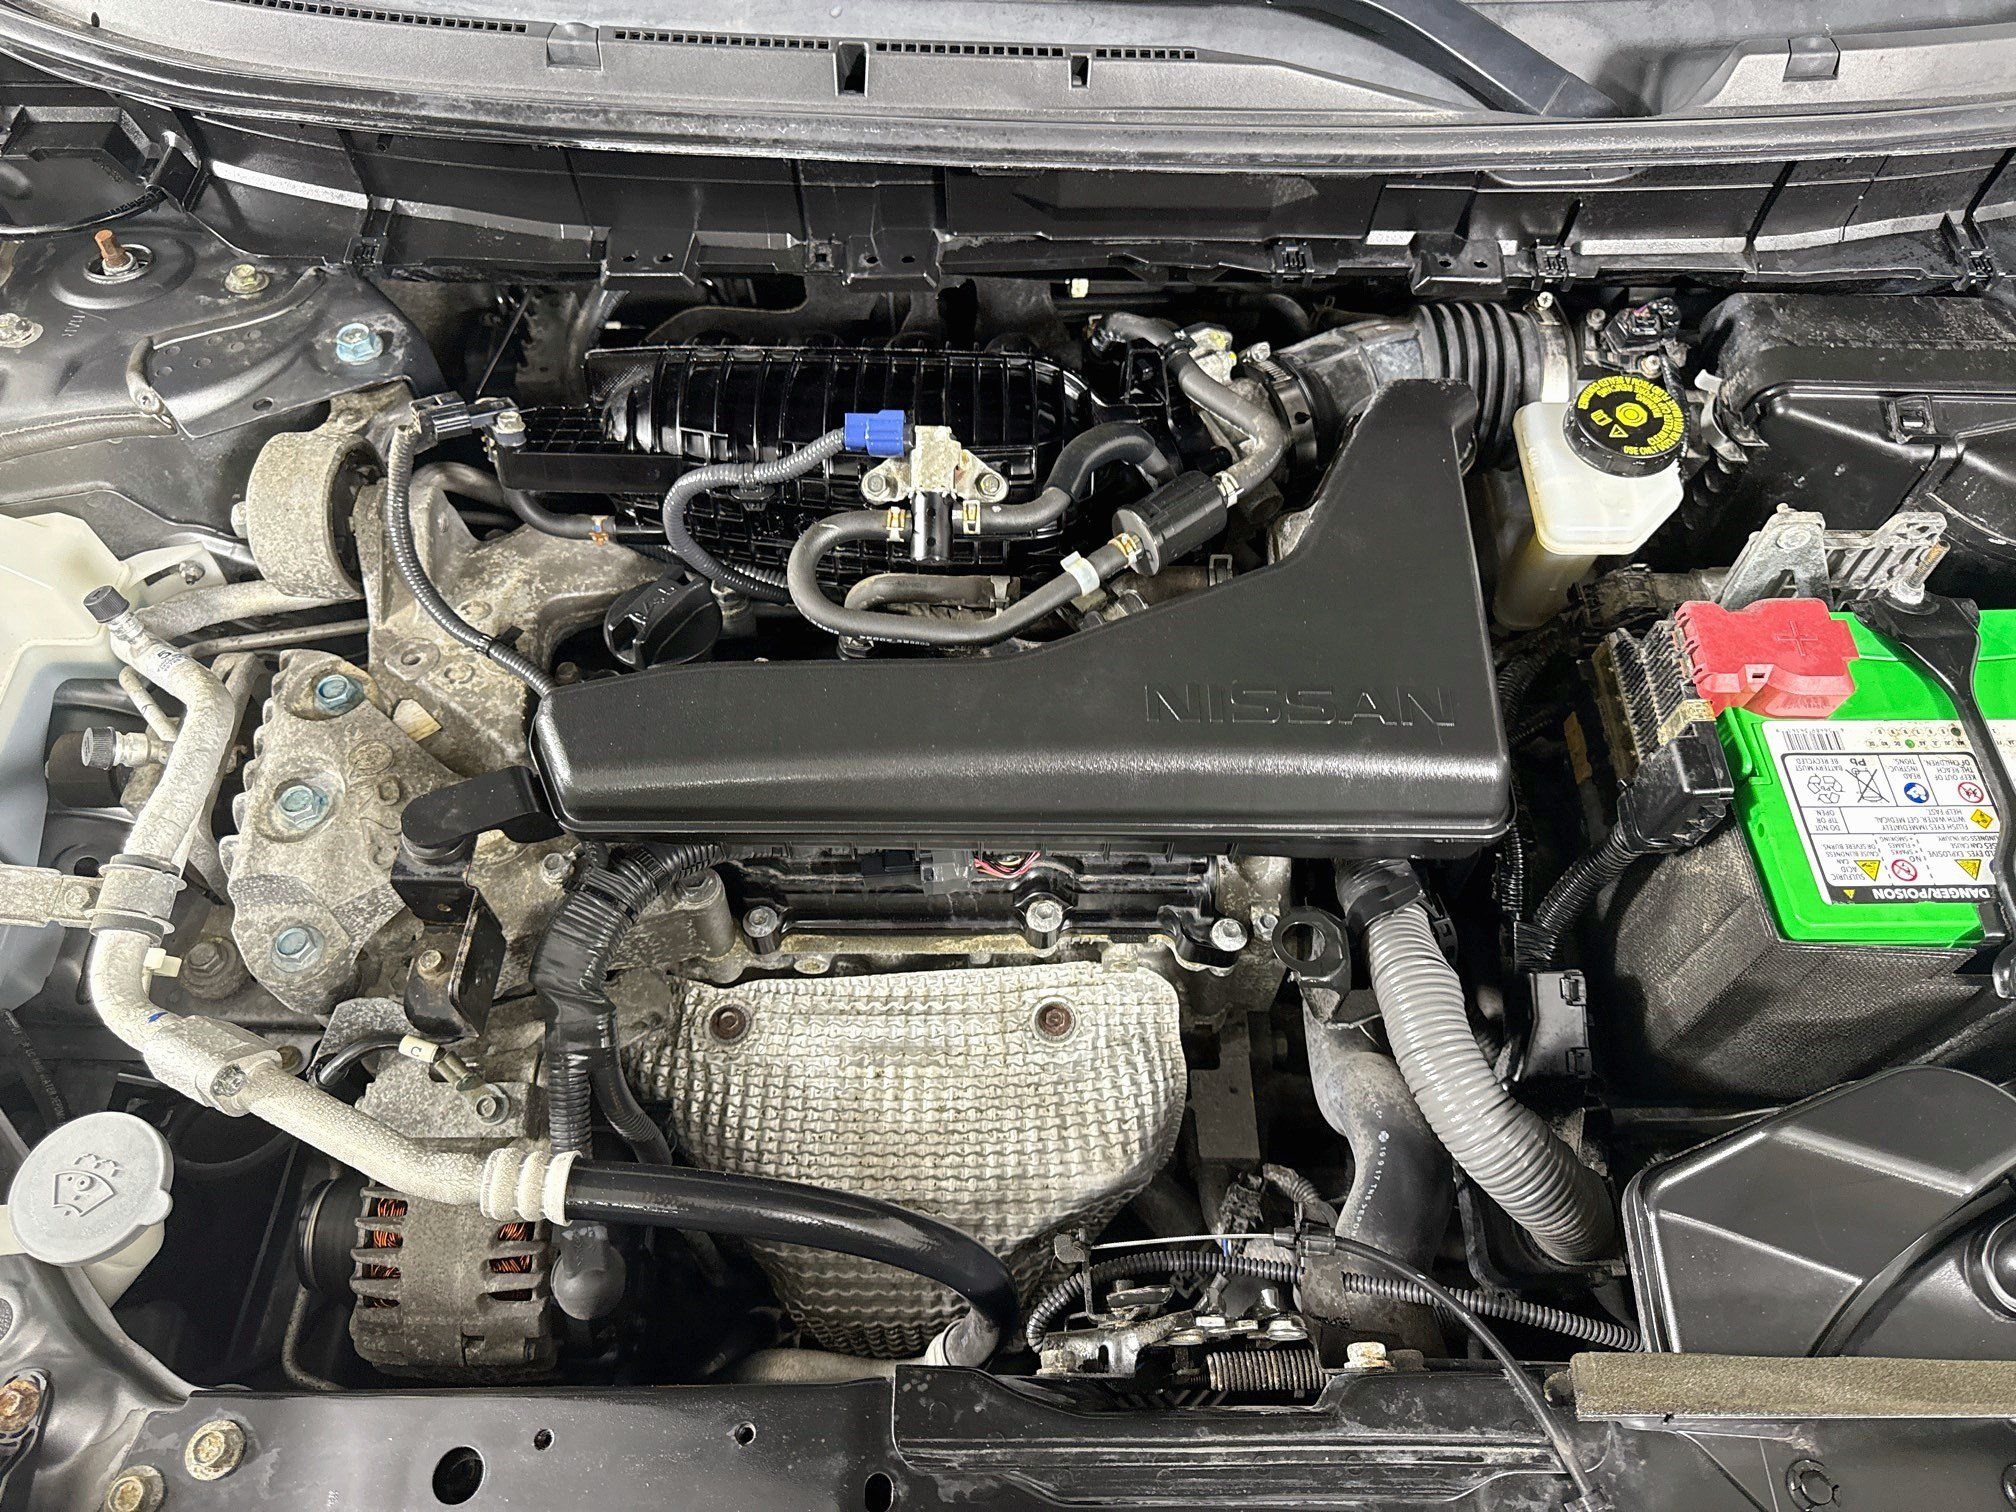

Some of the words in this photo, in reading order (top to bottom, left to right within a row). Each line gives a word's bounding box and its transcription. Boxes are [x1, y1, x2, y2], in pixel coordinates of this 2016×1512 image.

[1624, 446, 1639, 455] USE
[1639, 445, 1660, 456] ONLY
[1145, 684, 1456, 726] NISSAN
[1872, 887, 1990, 899] DANGER/POISON
